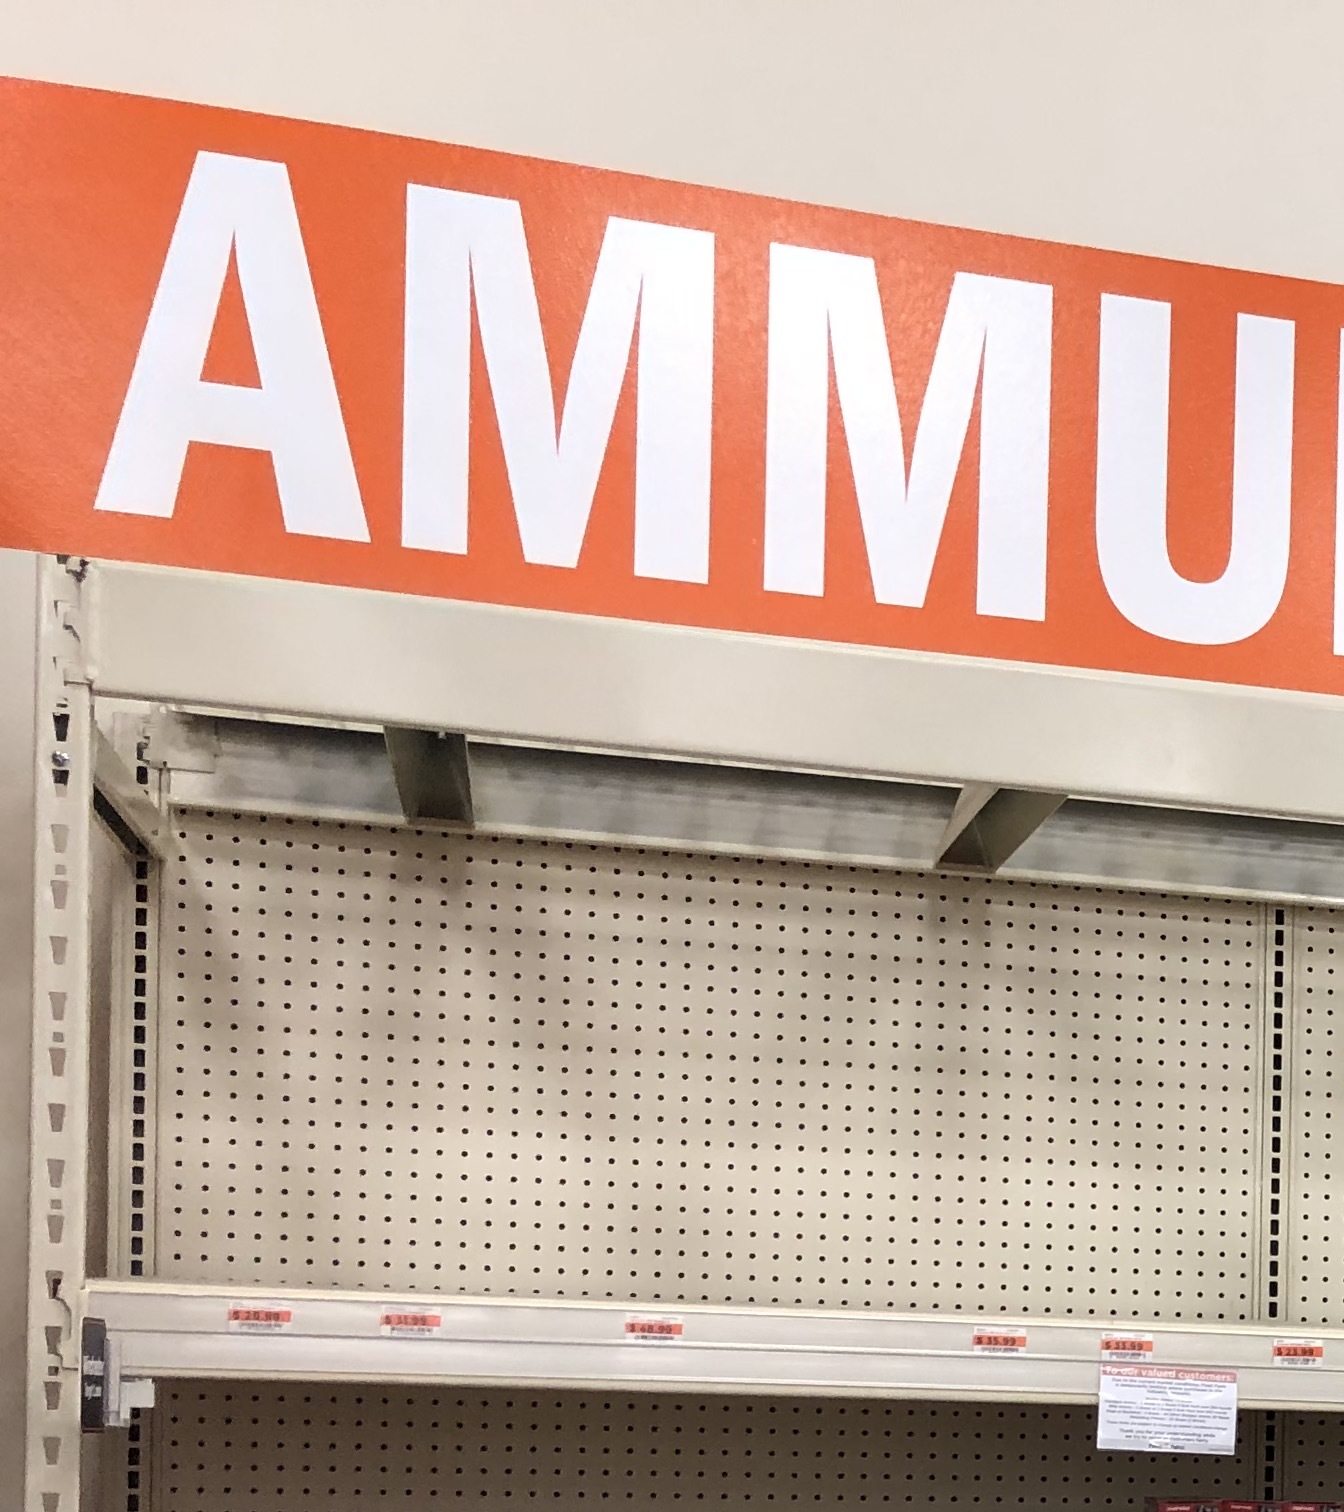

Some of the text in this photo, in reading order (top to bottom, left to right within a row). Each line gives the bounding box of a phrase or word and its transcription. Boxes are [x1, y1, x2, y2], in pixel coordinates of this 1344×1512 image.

[987, 1337, 1016, 1345] 35.99
[1115, 1342, 1143, 1350] 33.99
[1286, 1347, 1313, 1356] 23.99
[1106, 1366, 1116, 1374] To
[1141, 1369, 1175, 1378] valued
[1178, 1370, 1235, 1382] customers:
